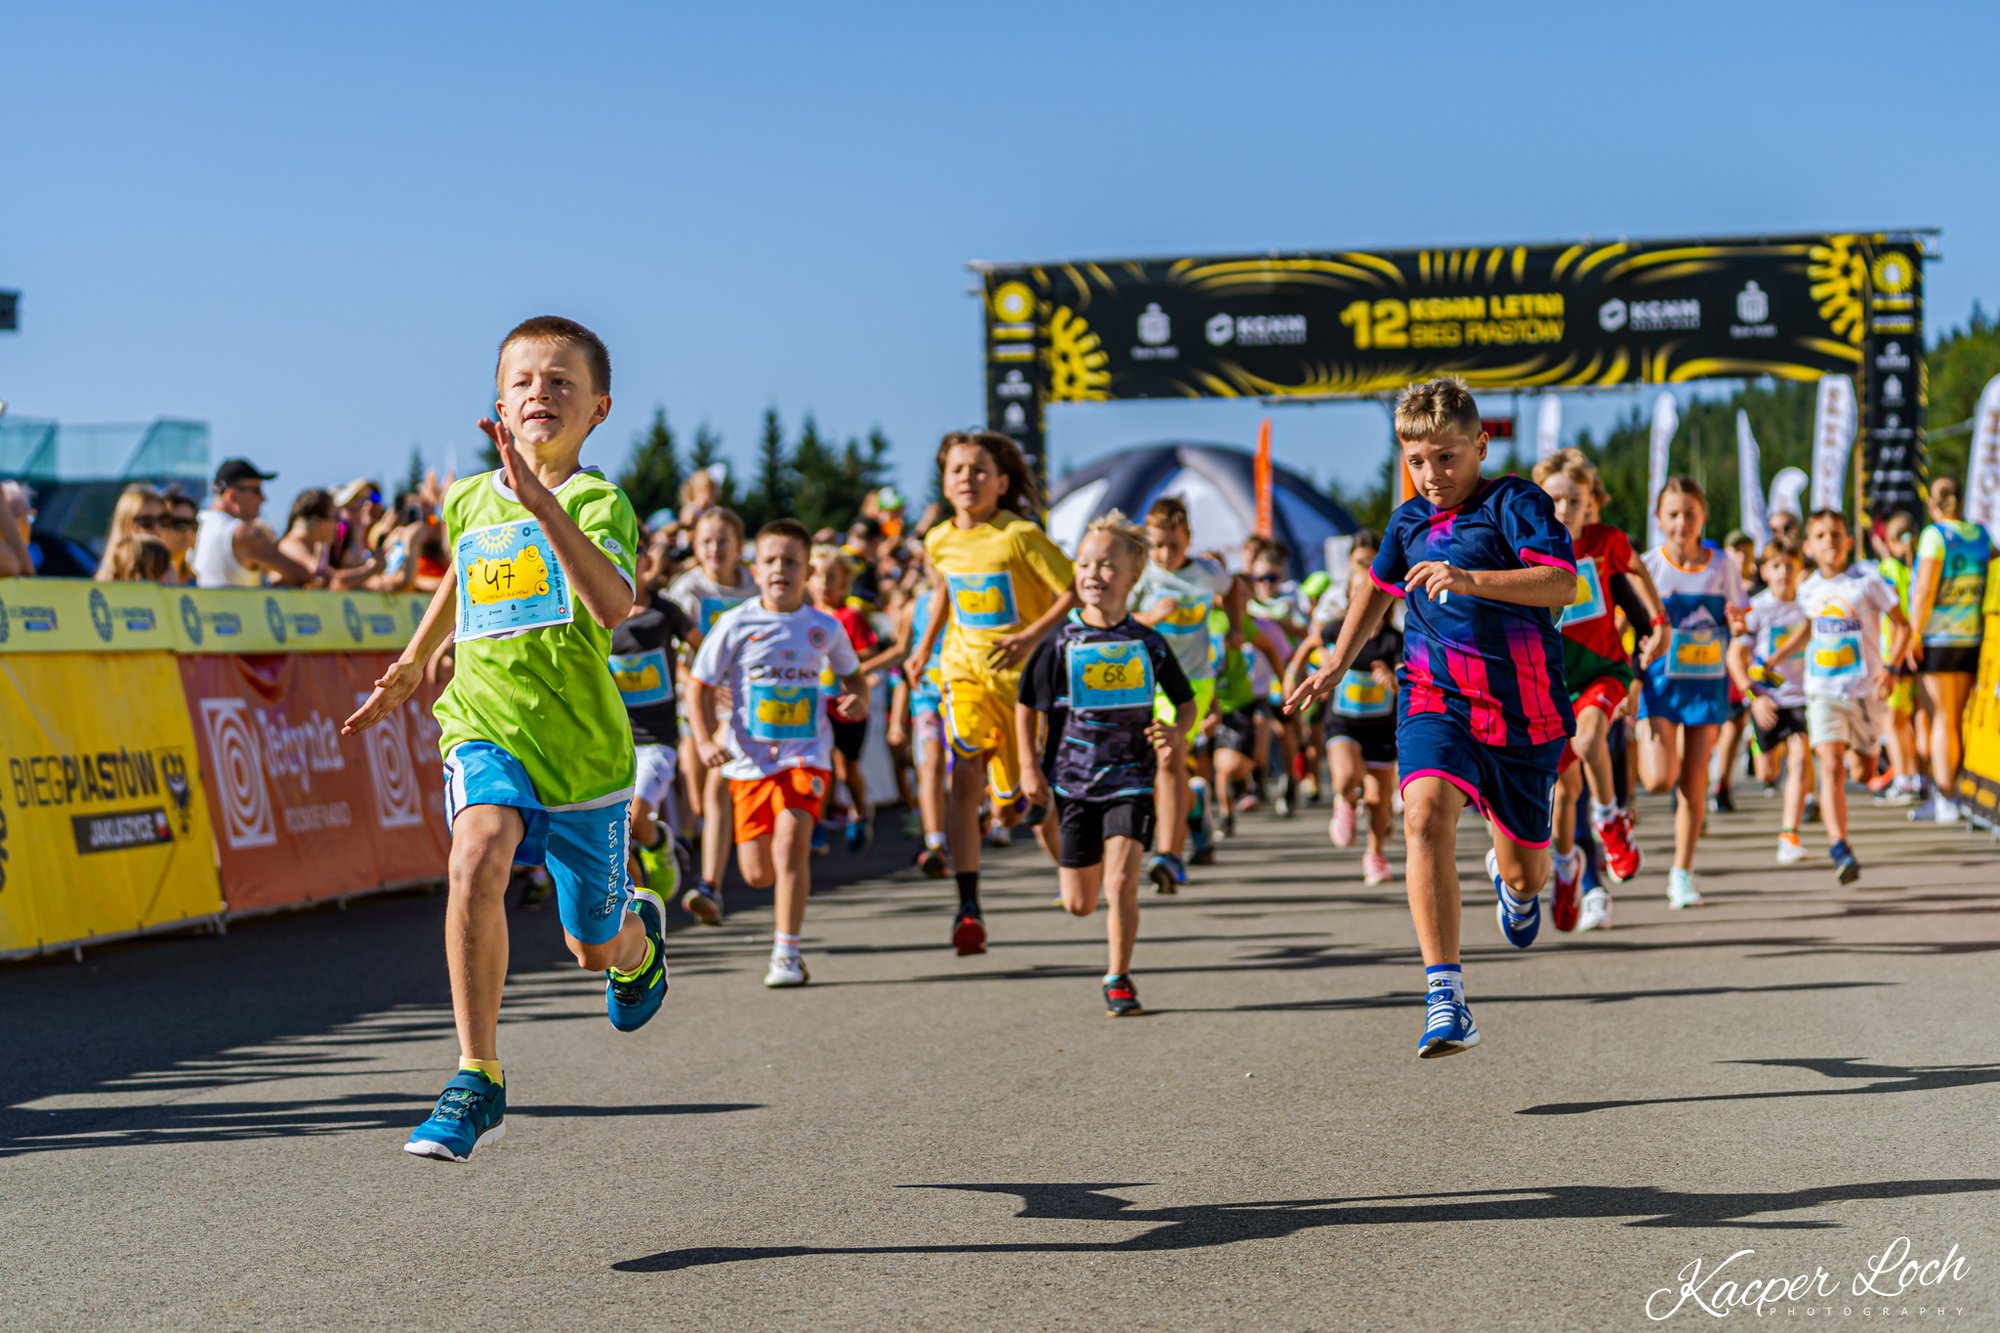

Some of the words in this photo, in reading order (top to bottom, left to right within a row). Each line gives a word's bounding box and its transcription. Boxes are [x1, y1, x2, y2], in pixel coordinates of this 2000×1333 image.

[1339, 299, 1410, 349] 12
[484, 563, 516, 591] 47
[1103, 664, 1127, 683] 68
[608, 820, 618, 848] LOS
[604, 852, 619, 914] ANGELES
